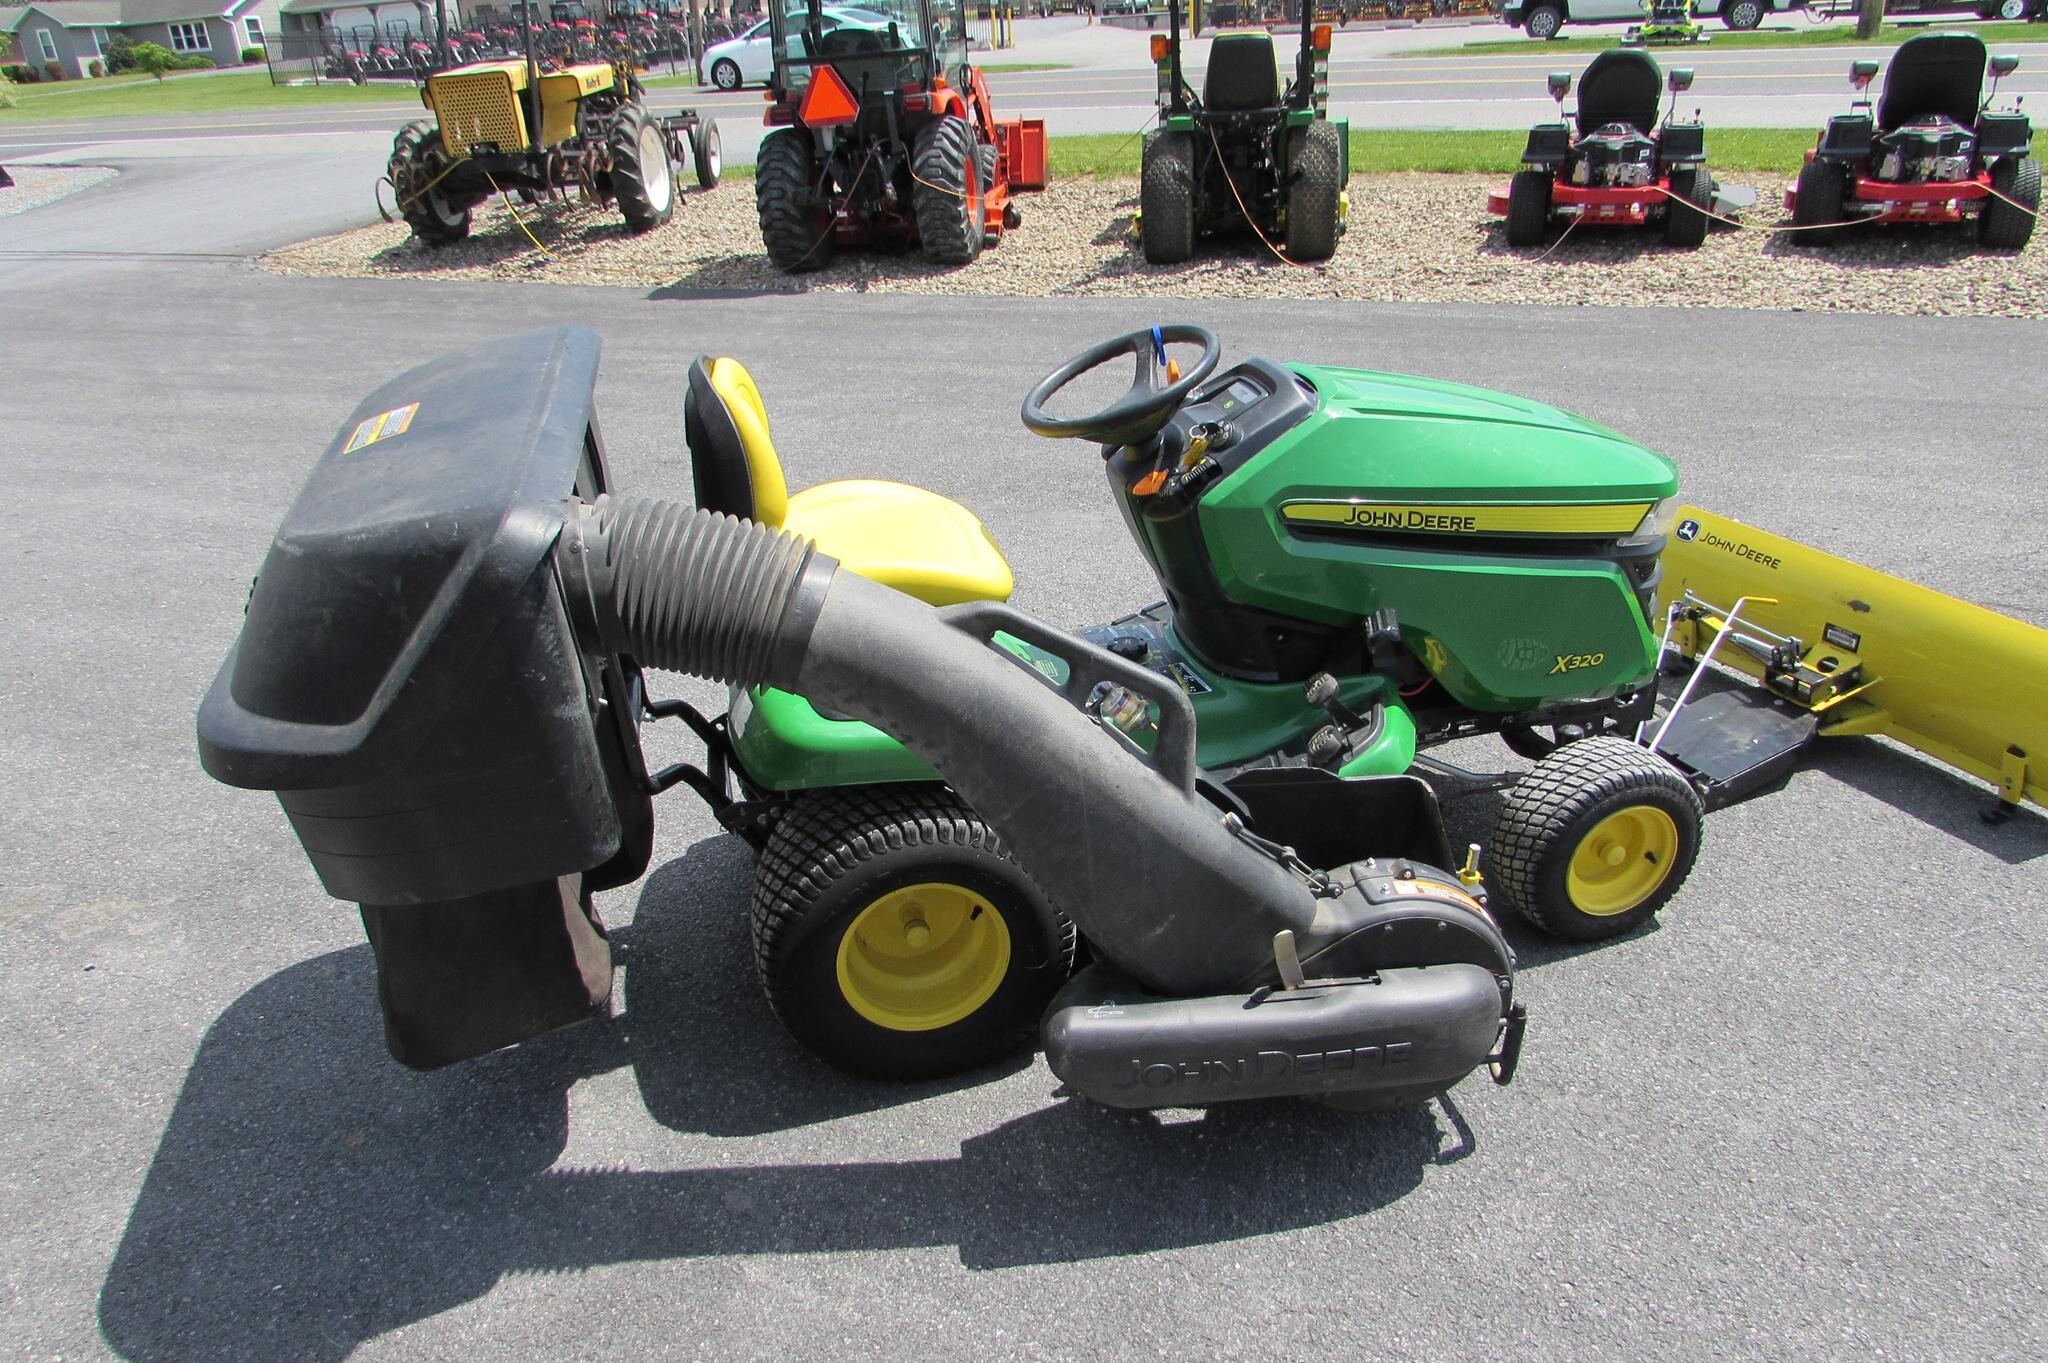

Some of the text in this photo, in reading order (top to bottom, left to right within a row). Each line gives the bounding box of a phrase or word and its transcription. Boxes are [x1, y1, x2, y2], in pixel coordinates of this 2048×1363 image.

[1344, 506, 1477, 531] JOHN DEERE
[1699, 532, 1781, 570] JOHN DEERE
[1545, 652, 1606, 677] X320
[1112, 1042, 1413, 1090] JOHN DEERE
